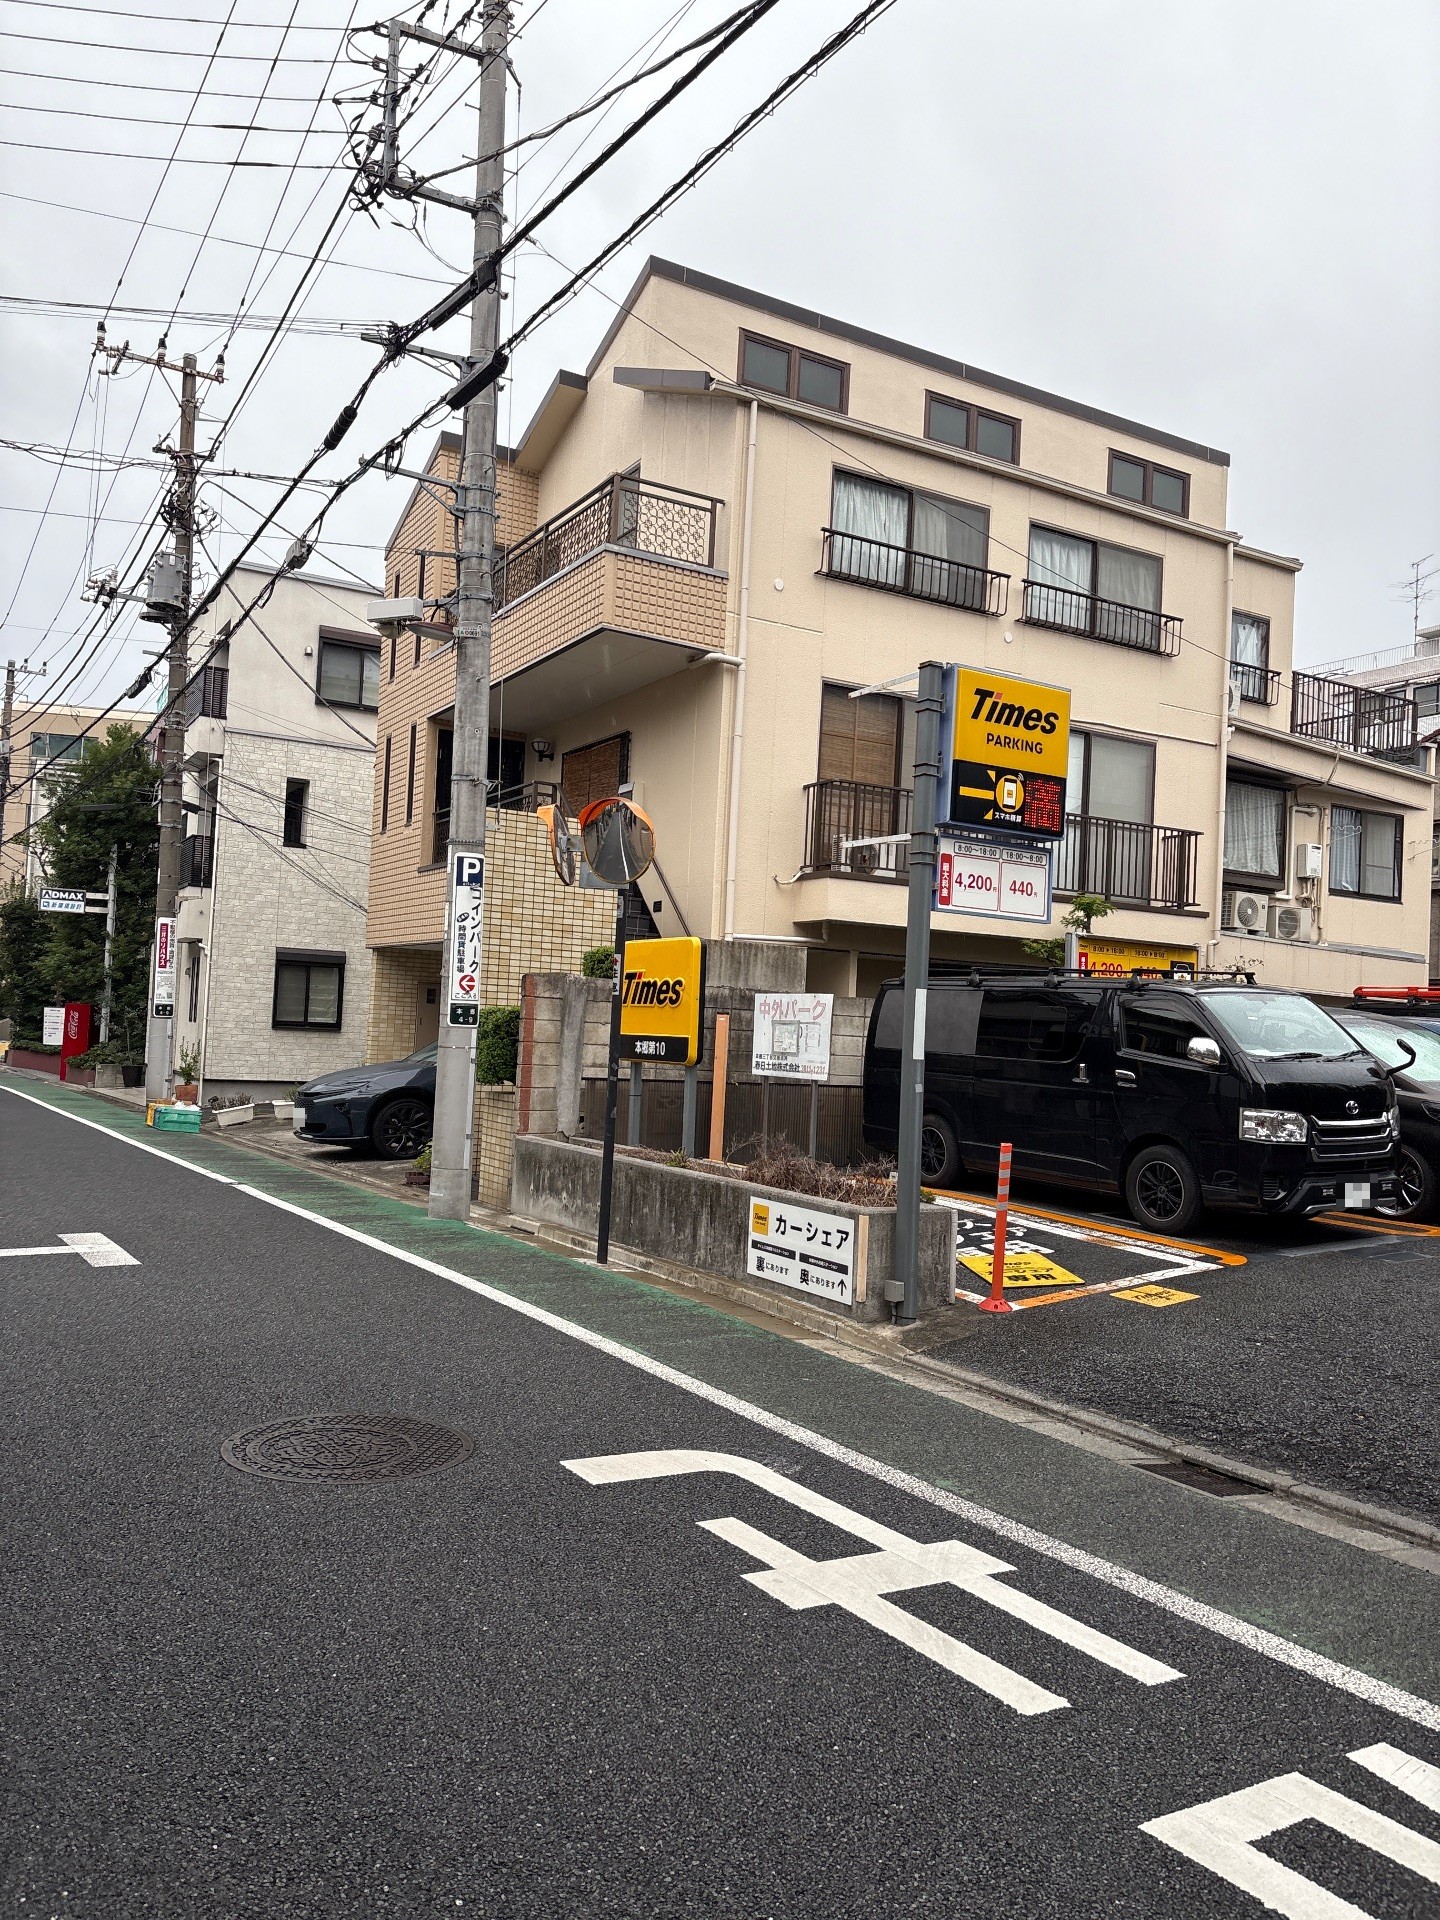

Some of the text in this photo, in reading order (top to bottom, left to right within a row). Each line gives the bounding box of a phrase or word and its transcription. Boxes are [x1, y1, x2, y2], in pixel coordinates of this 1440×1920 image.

[970, 687, 1060, 735] Times
[986, 732, 1044, 755] PARKING
[1024, 779, 1061, 831] 満
[463, 857, 481, 882] P
[941, 863, 949, 897] 最大料金
[469, 887, 482, 973] コインパーク
[622, 971, 684, 1006] Times
[759, 999, 827, 1020] 中外パーク
[635, 1040, 666, 1056] 本郷第10
[754, 1212, 767, 1222] Times
[775, 1213, 850, 1250] カーシェア
[756, 1255, 790, 1275] 裏にあります
[800, 1268, 836, 1290] 奥にあります
